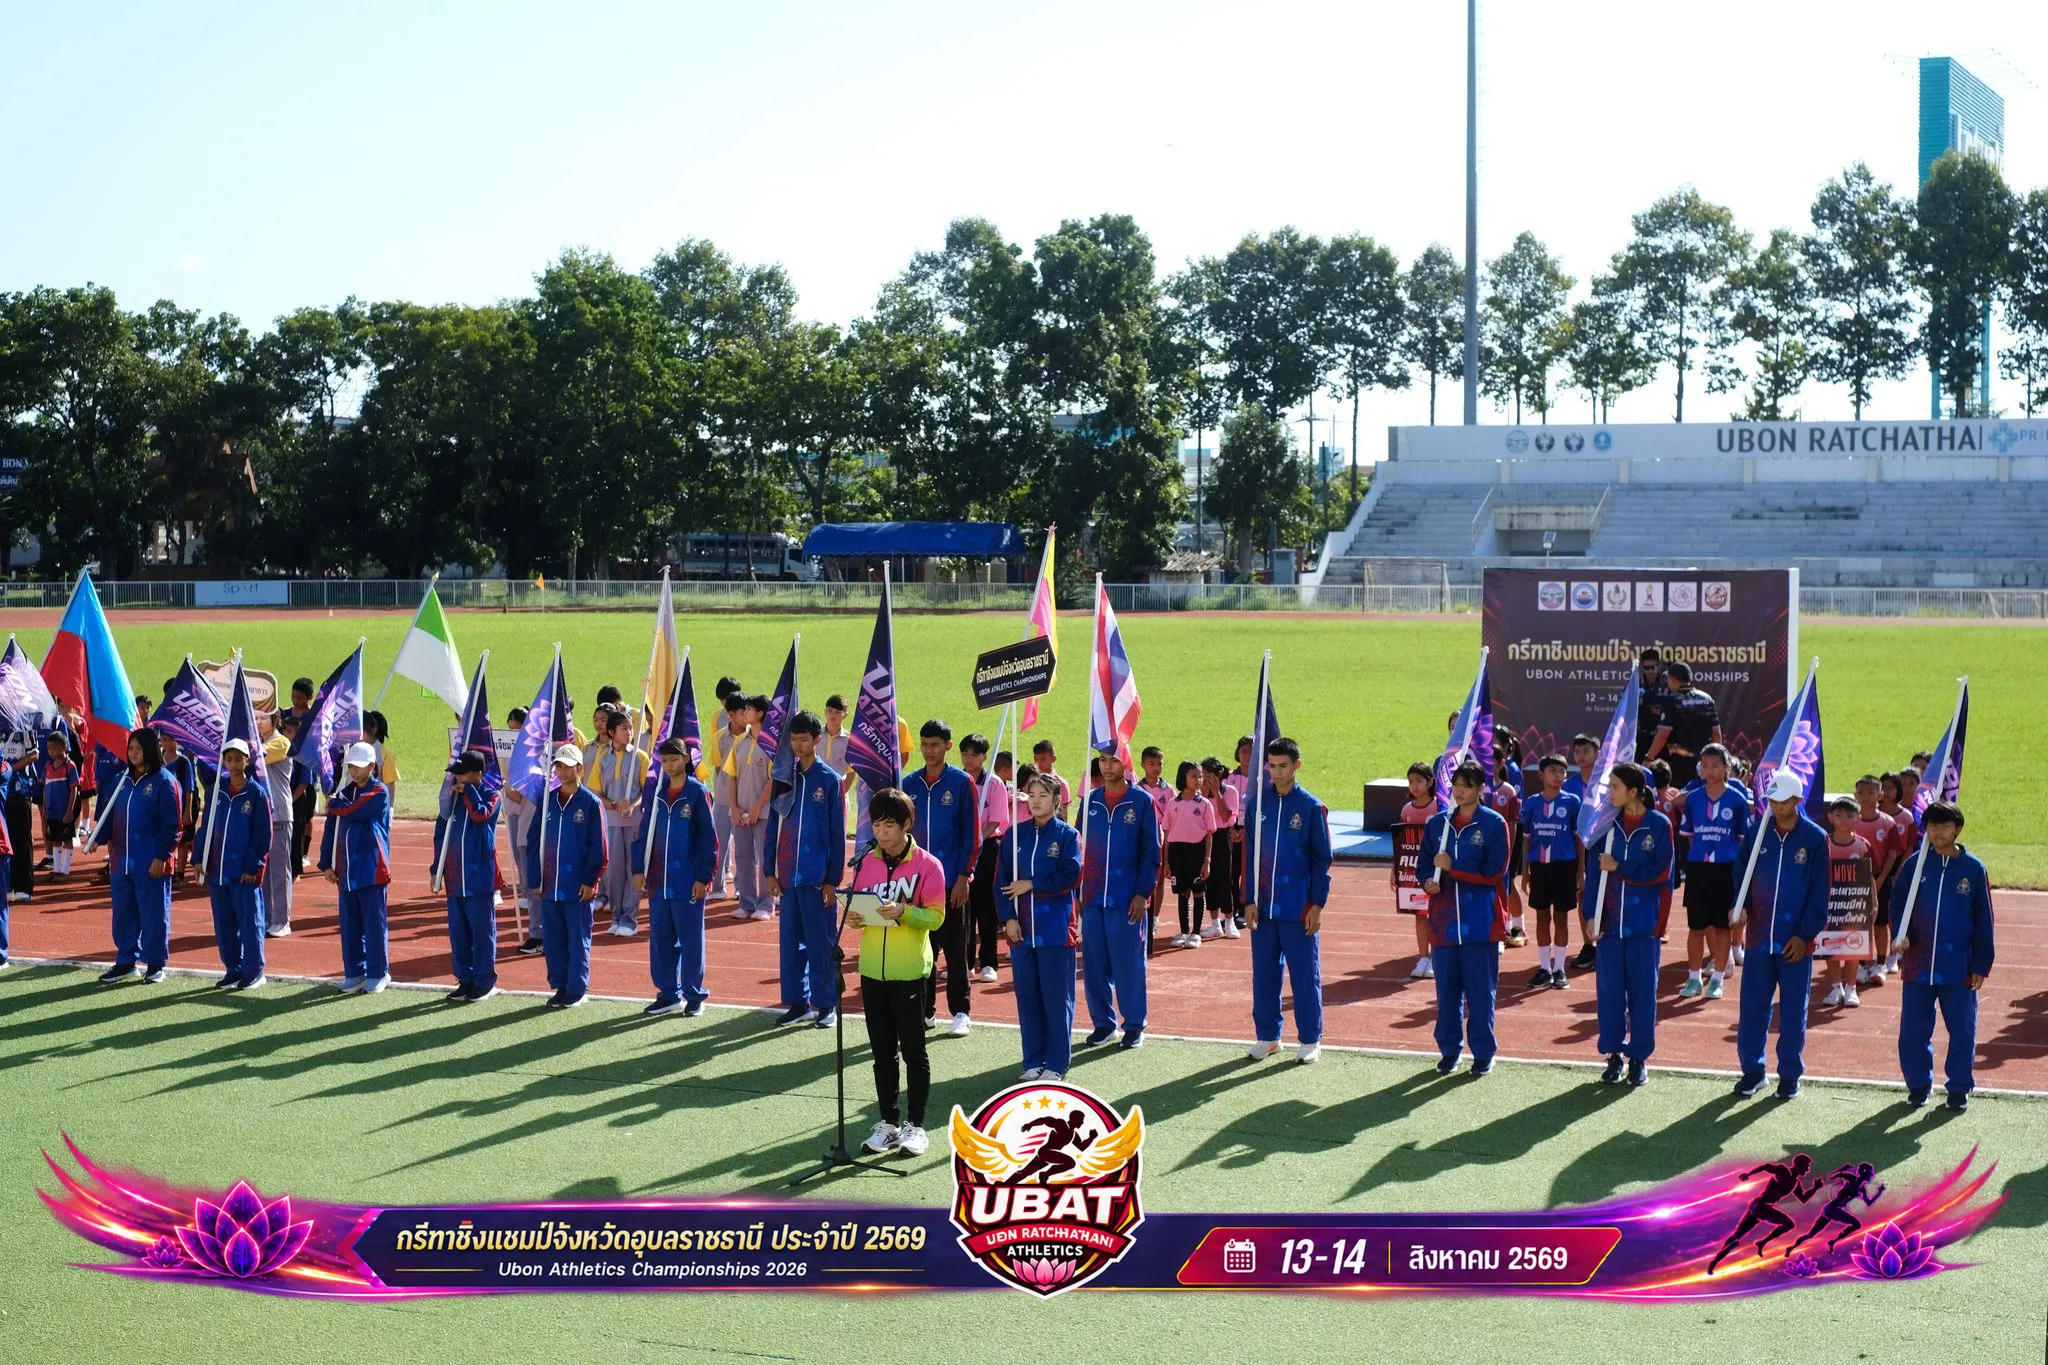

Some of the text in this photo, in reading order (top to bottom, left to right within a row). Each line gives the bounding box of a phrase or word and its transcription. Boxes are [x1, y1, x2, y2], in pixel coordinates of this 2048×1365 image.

[1716, 428, 1796, 453] UBON
[1526, 669, 1563, 679] UBON
[1568, 670, 1631, 681] ATHLETIC
[978, 672, 1047, 697] UBON ATHLETICS CHAMPIONSHIPS
[1401, 843, 1415, 851] YOU
[1834, 864, 1857, 882] MOVE
